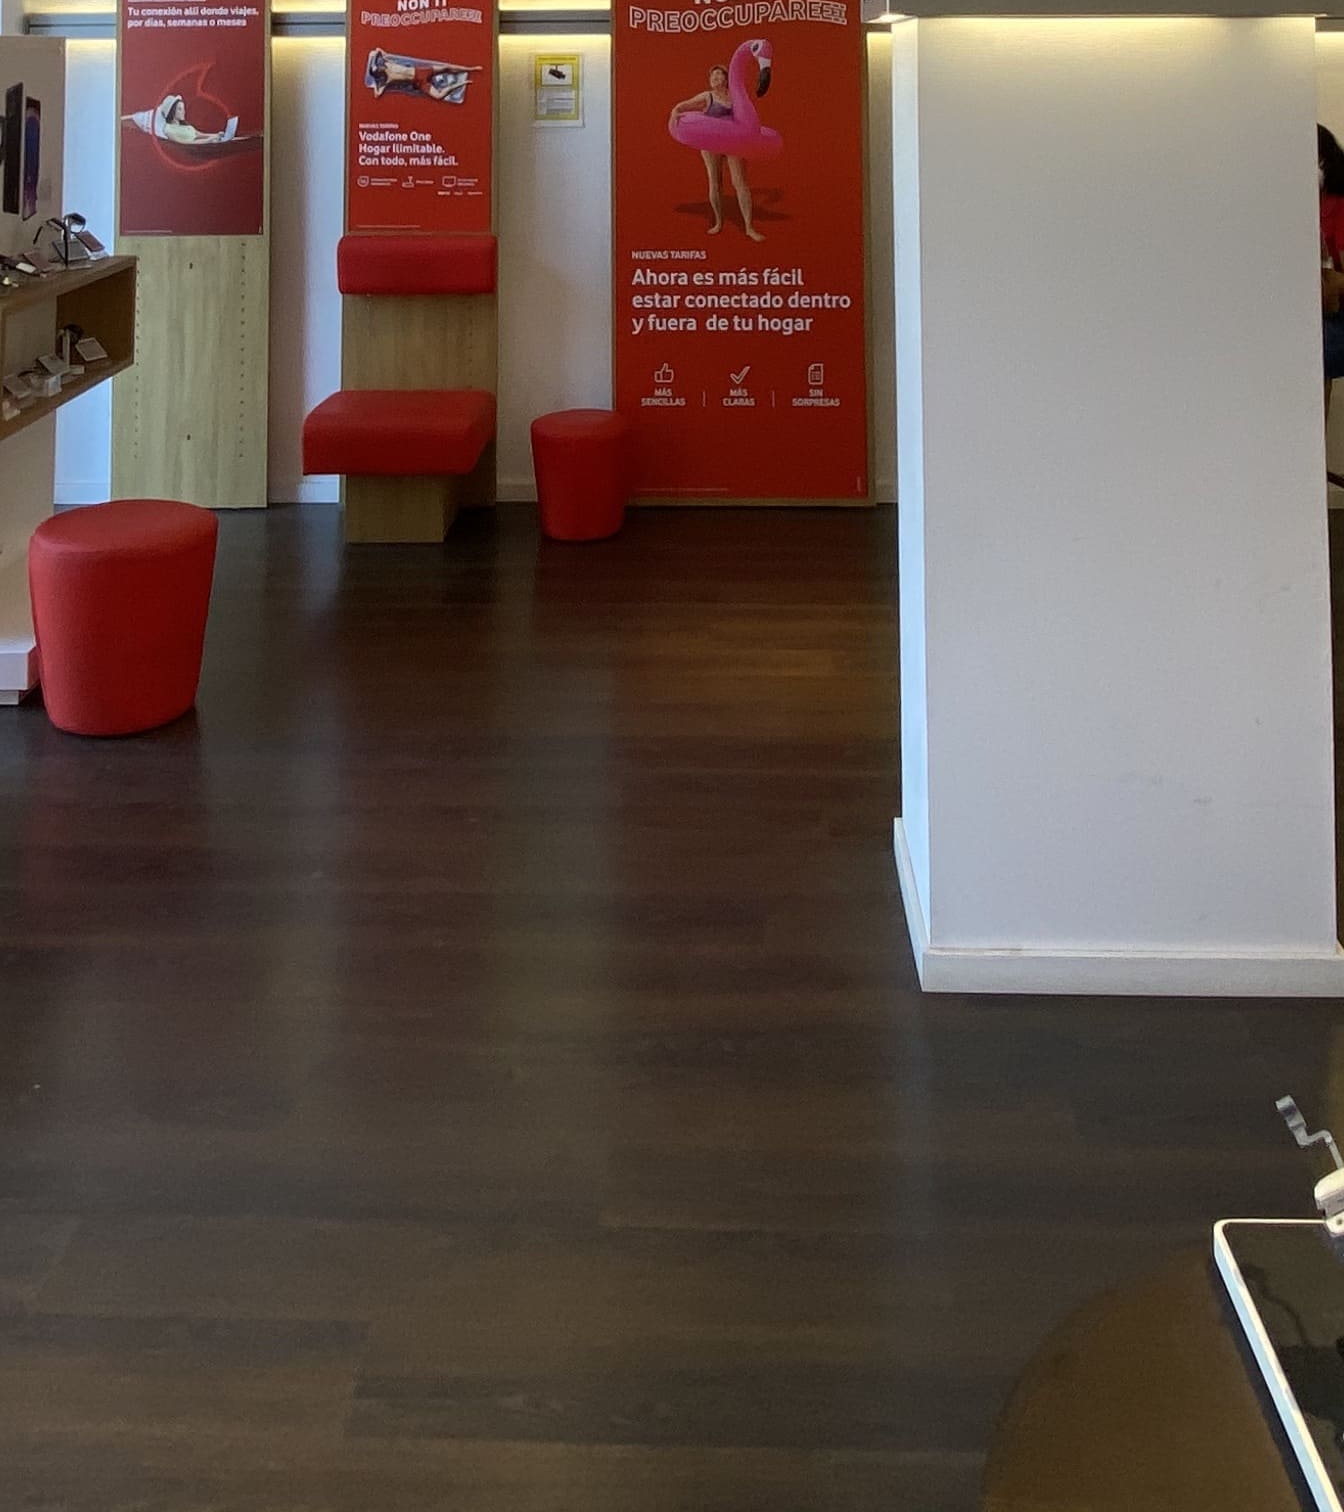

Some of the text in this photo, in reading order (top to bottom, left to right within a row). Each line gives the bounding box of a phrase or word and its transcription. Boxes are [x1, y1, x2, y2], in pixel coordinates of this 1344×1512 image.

[128, 7, 139, 16] Tu
[359, 131, 432, 141] Vodafone One
[359, 144, 391, 155] Hogar
[359, 155, 379, 166] Con
[381, 156, 408, 167] todo,
[410, 155, 432, 166] más
[631, 250, 706, 260] NUEVAS TARIFAS
[632, 268, 804, 286] Ahora es más fácil
[632, 291, 851, 308] estar conectado dentro
[631, 314, 813, 335] y fuera de tu hogar
